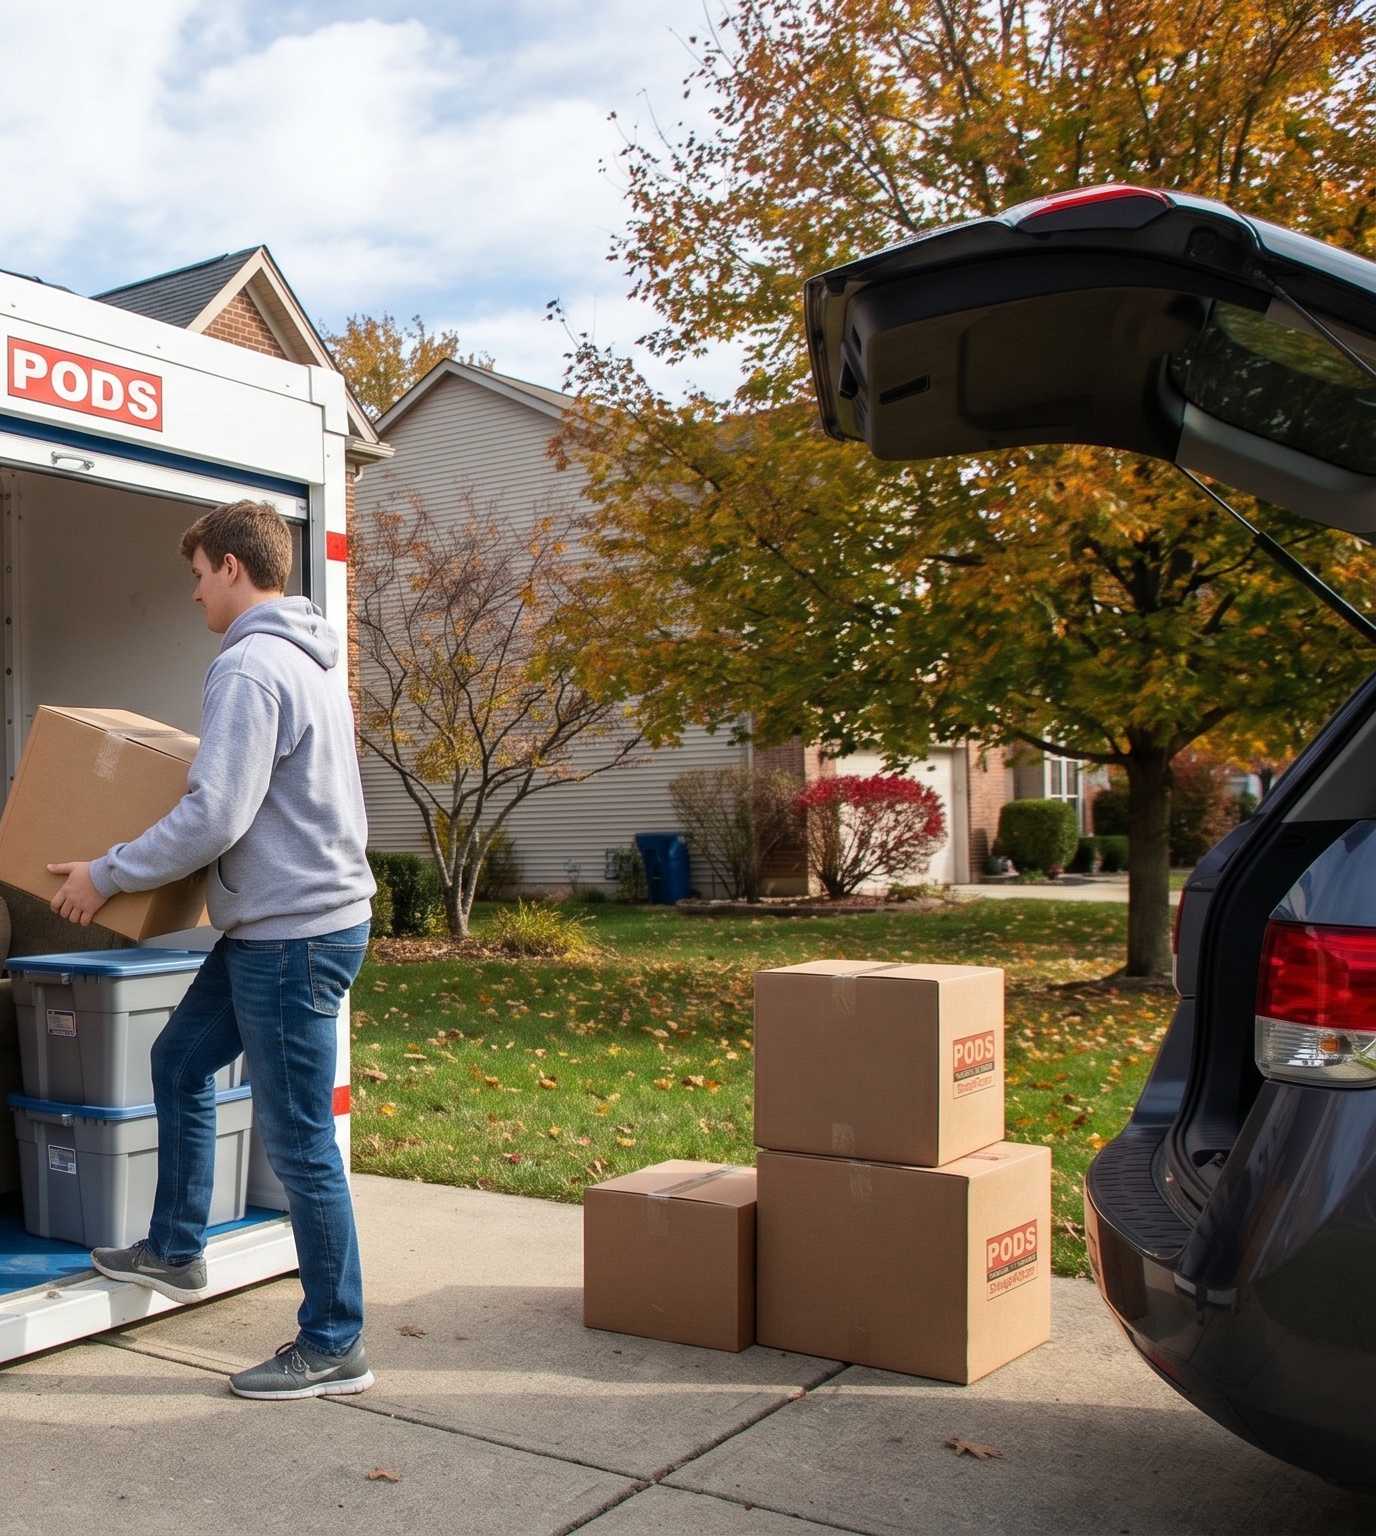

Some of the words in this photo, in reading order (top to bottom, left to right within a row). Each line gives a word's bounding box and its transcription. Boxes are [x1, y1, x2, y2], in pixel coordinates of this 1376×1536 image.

[13, 347, 158, 421] PODS
[954, 1035, 994, 1068] PODS
[987, 1226, 1036, 1268] PODS
